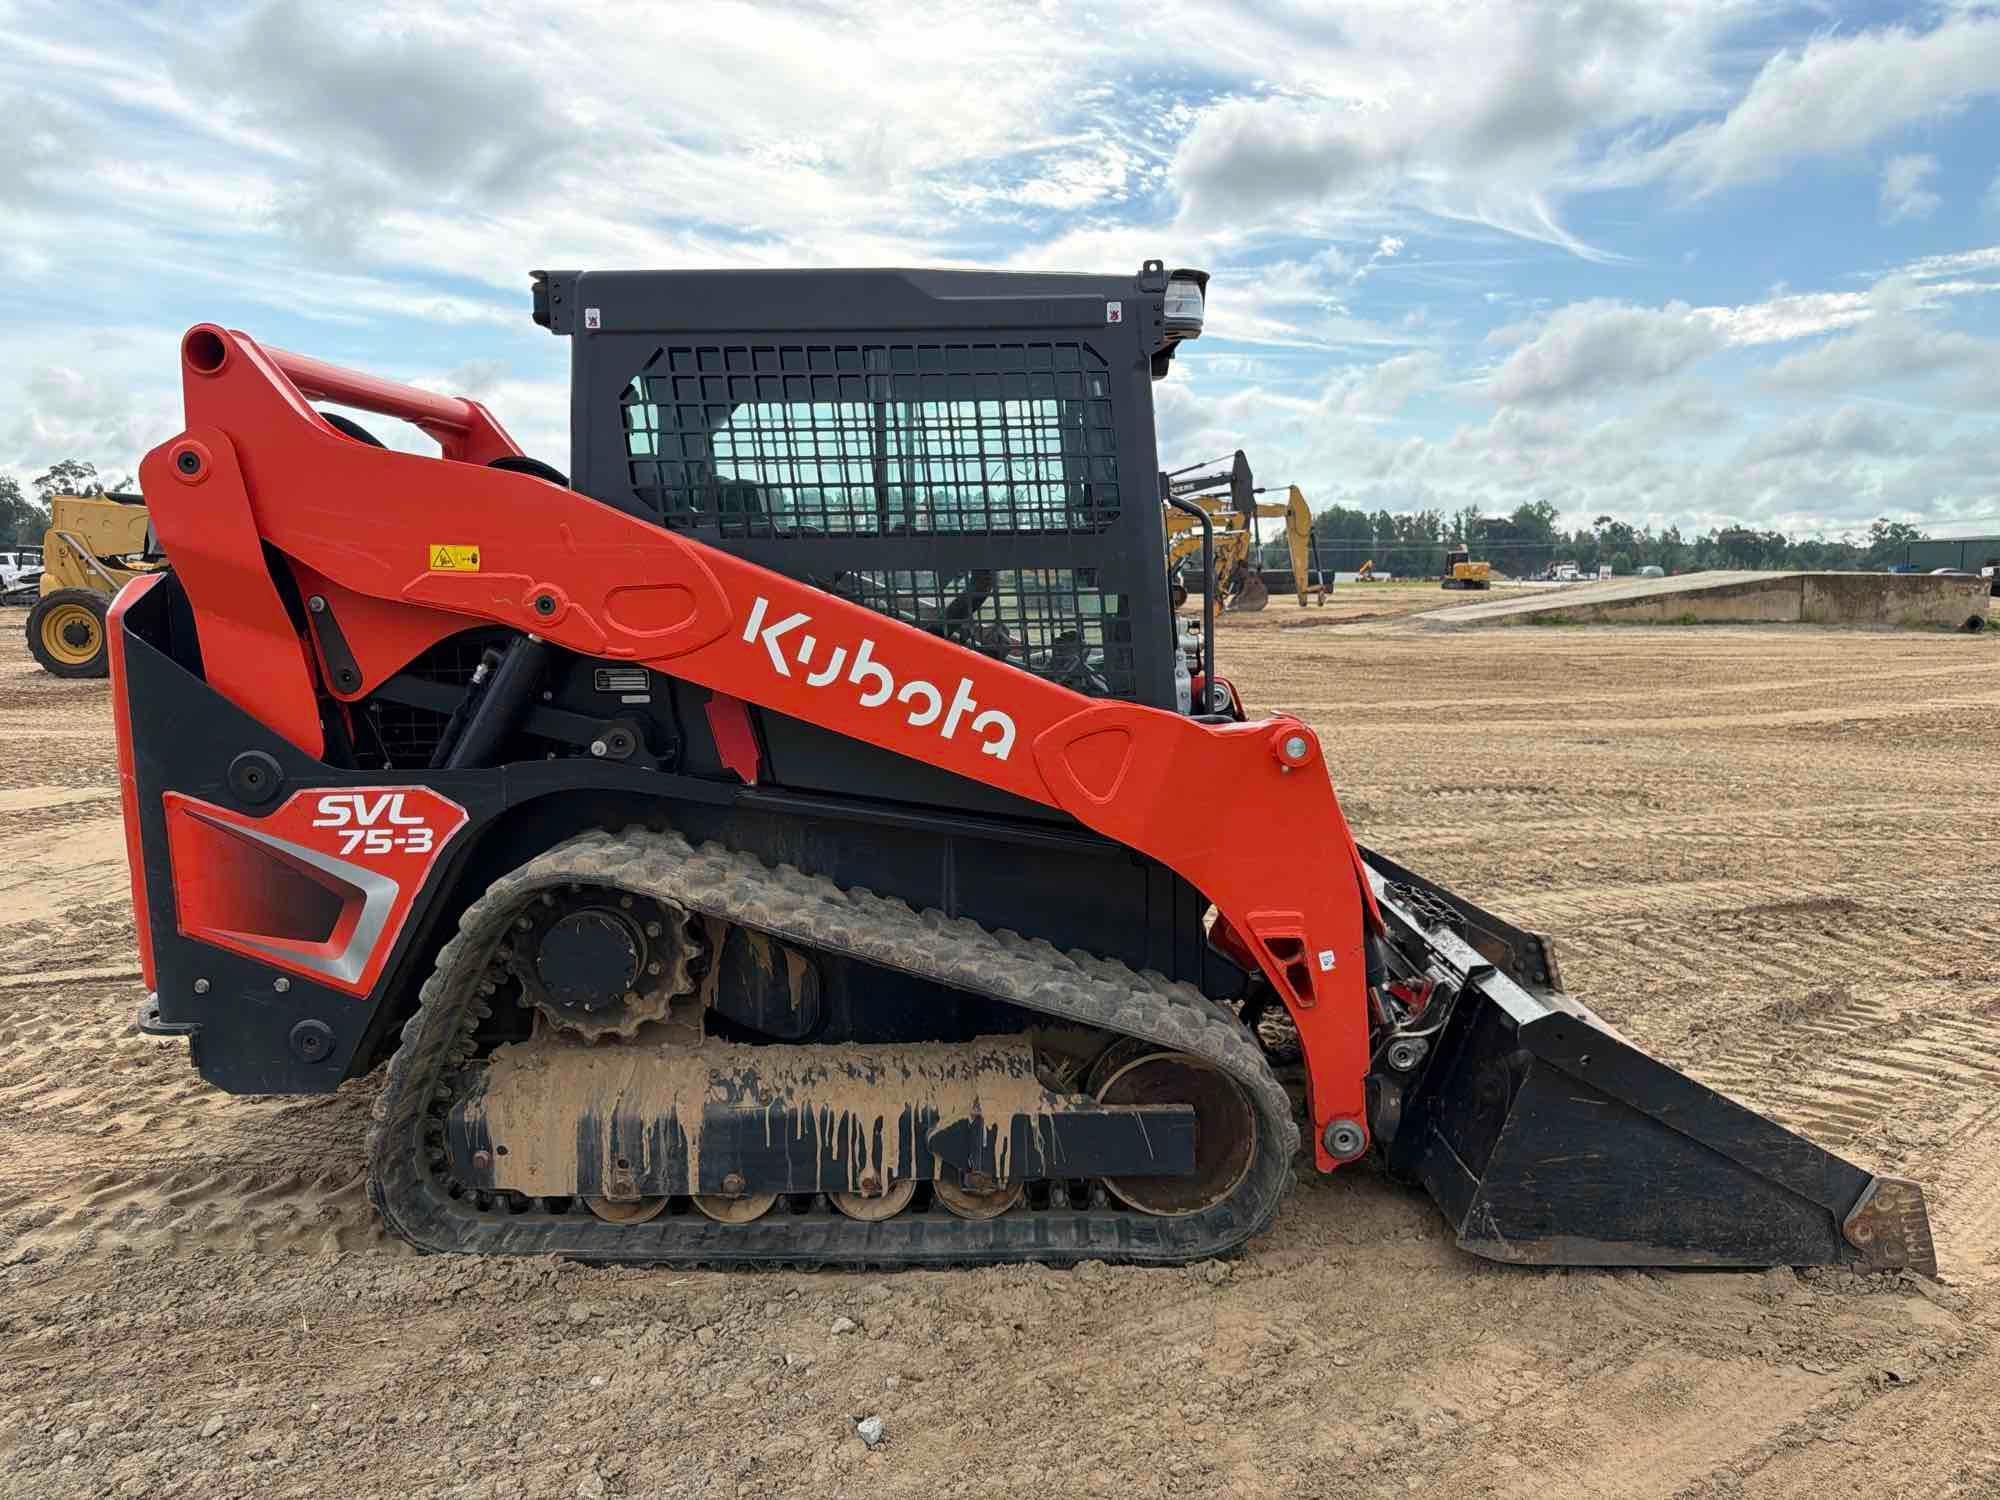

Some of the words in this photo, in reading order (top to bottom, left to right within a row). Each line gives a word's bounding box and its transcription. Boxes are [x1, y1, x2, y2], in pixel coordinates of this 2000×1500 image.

[742, 596, 1016, 760] Kubota
[312, 793, 425, 827] SVL
[338, 828, 433, 855] 75-3
